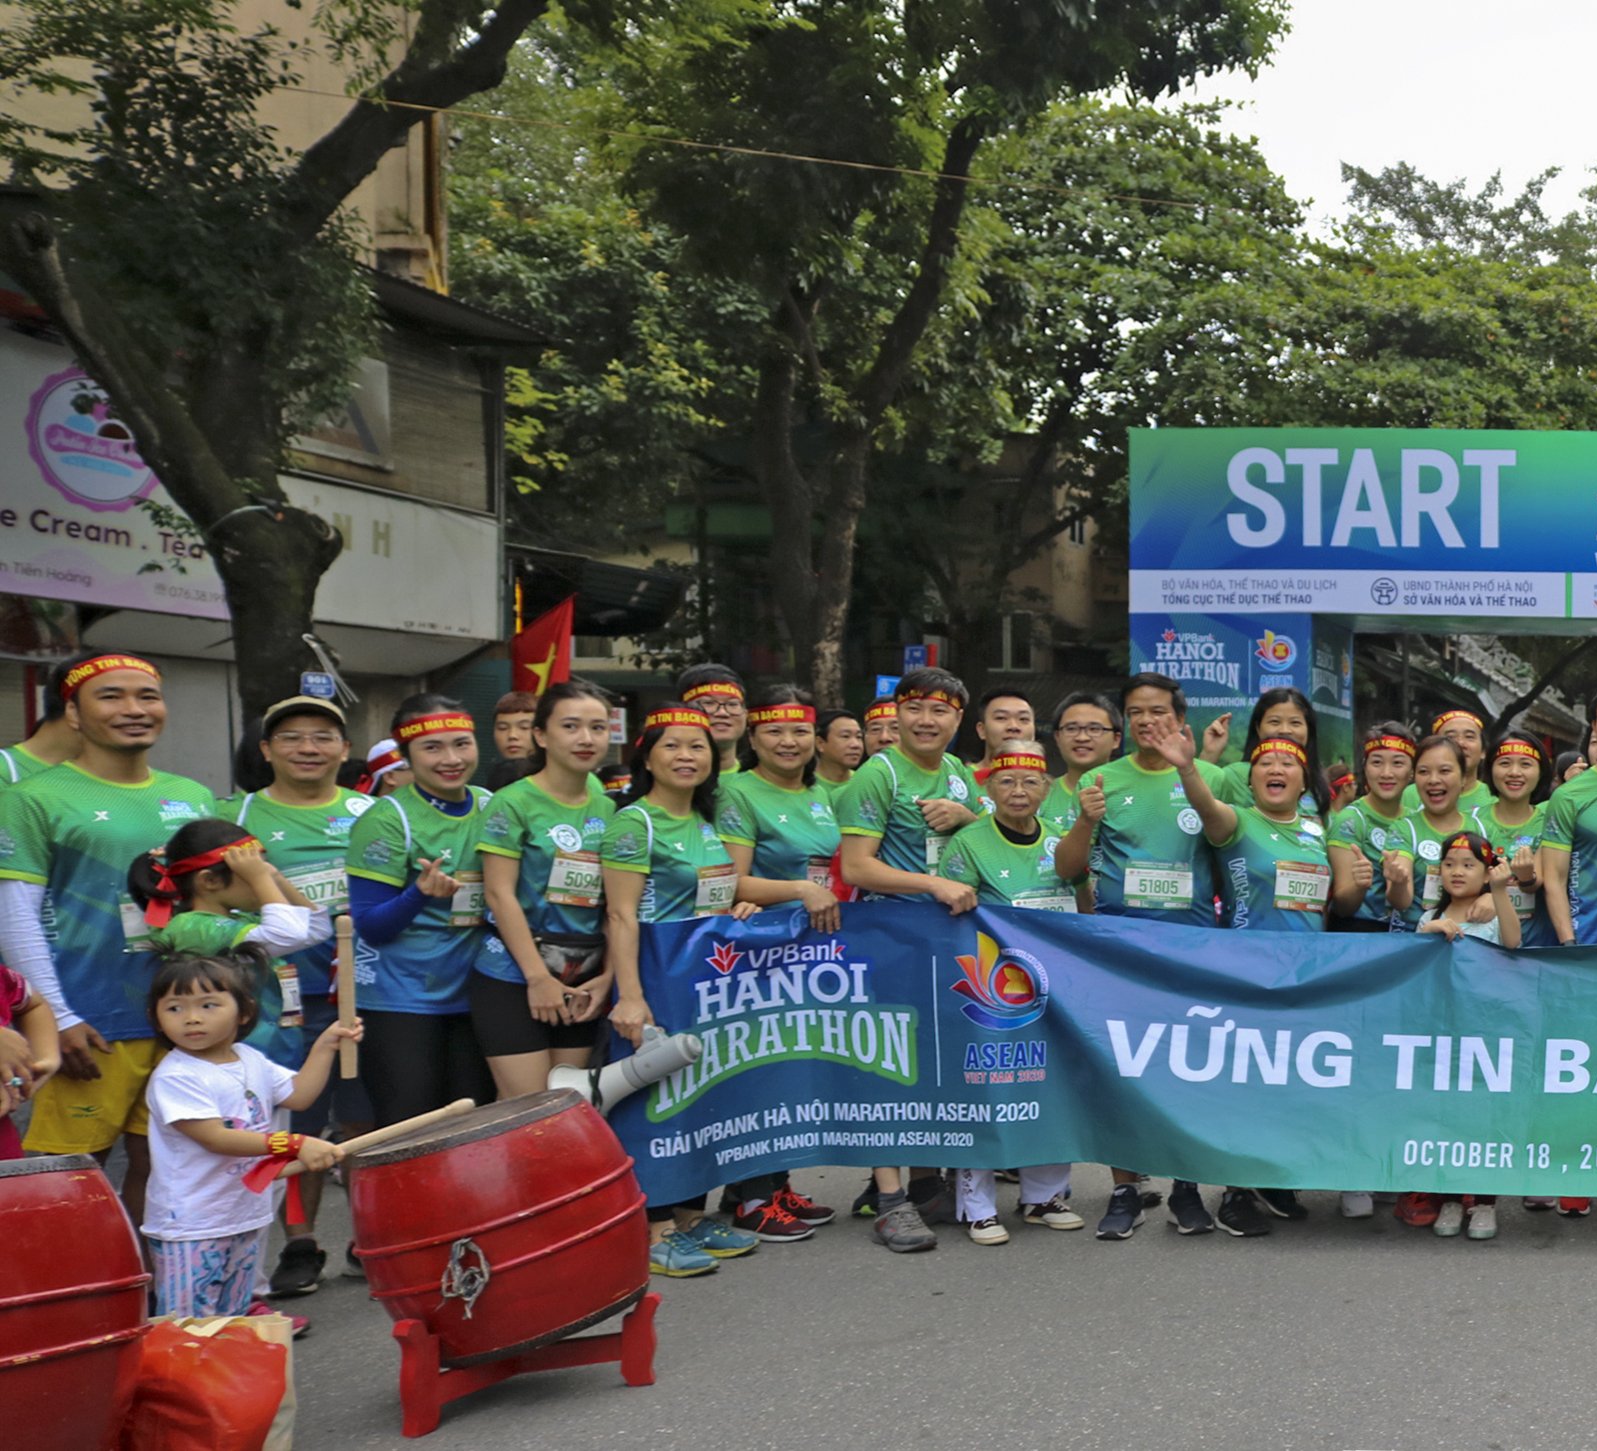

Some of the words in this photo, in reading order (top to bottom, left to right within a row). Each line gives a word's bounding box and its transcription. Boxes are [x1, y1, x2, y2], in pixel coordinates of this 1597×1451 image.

[1226, 446, 1517, 549] START
[30, 509, 131, 547] Cream
[159, 531, 205, 559] Tea
[1251, 579, 1279, 590] THAO
[1403, 580, 1431, 591] UBND
[1434, 578, 1470, 591] THÀNH
[1497, 579, 1511, 592] HÀ
[1284, 594, 1313, 605] THAO
[1469, 594, 1484, 606] VÀ
[1508, 596, 1537, 607] THAO
[1178, 632, 1215, 642] VPBank
[1155, 642, 1225, 660] HANOI
[95, 657, 120, 670] TIN
[1139, 661, 1240, 690] MARATHON
[1200, 697, 1245, 707] MARATHON
[424, 719, 444, 732] MAI
[657, 712, 671, 722] TIN
[564, 870, 600, 890] 5094
[1139, 877, 1179, 894] 51805
[1288, 879, 1319, 897] 50721
[748, 938, 846, 968] VPBank
[694, 961, 869, 1023] HANOI
[963, 1040, 1047, 1070] ASEAN
[1105, 1006, 1353, 1088] VỮNG
[1382, 1034, 1513, 1093] TIN
[654, 1008, 912, 1114] MARATHON
[964, 1071, 987, 1084] VIET
[989, 1071, 1014, 1083] NAM
[1017, 1069, 1046, 1083] 2020
[650, 1131, 690, 1159] GIẢI
[694, 1115, 760, 1149] VPBANK
[763, 1103, 792, 1129] HÀ
[795, 1099, 830, 1127] NỘI
[834, 1102, 933, 1122] MARATHON
[936, 1103, 991, 1123] ASEAN
[994, 1101, 1040, 1122] 2020
[716, 1139, 771, 1166] VPBANK
[773, 1133, 820, 1152] HANOI
[822, 1131, 895, 1147] MARATHON
[897, 1131, 940, 1147] ASEAN
[943, 1131, 974, 1147] 2020
[1403, 1139, 1513, 1169] OCTOBER
[1527, 1141, 1551, 1169] 18
